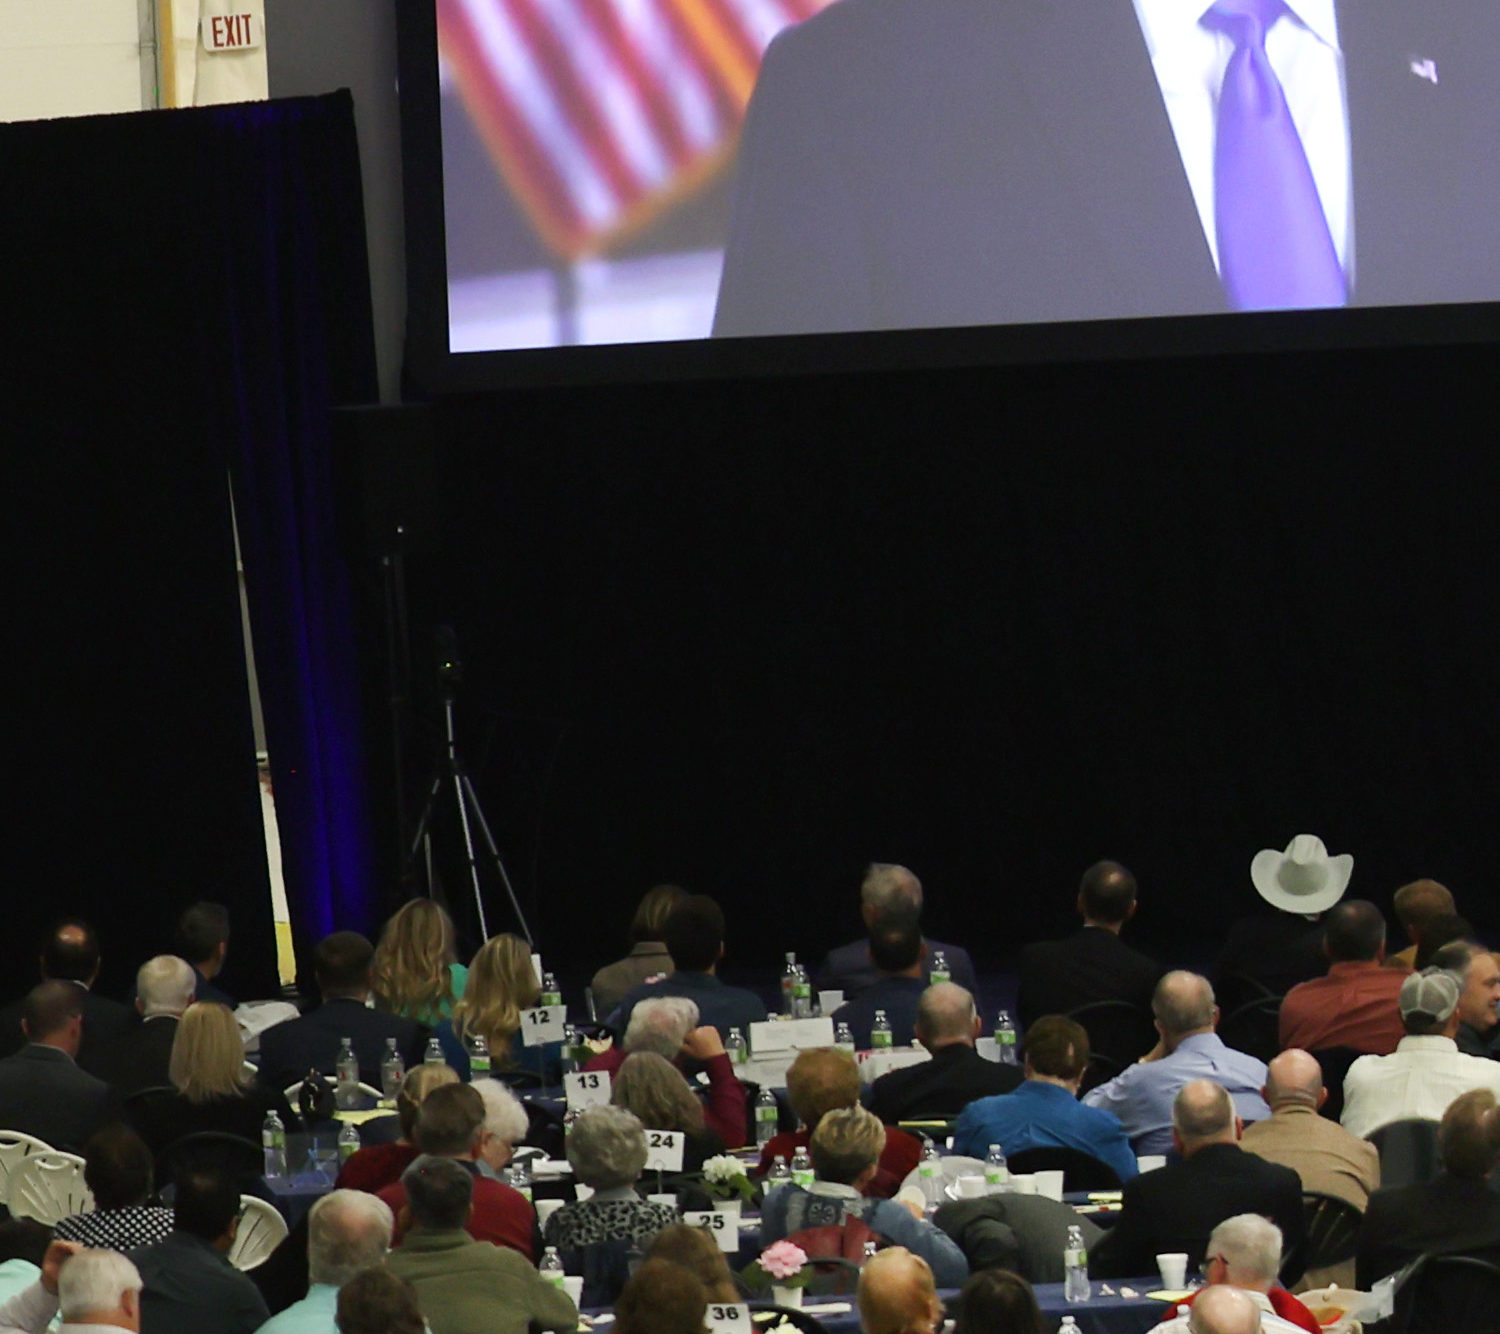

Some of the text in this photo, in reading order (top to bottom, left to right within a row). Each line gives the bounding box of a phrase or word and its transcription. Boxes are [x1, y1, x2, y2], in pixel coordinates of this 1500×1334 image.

[212, 14, 252, 48] EXIT
[529, 1010, 550, 1025] 12
[578, 1074, 599, 1089] 13
[650, 1133, 674, 1148] 24
[700, 1215, 724, 1229] 25
[712, 1307, 739, 1321] 36
